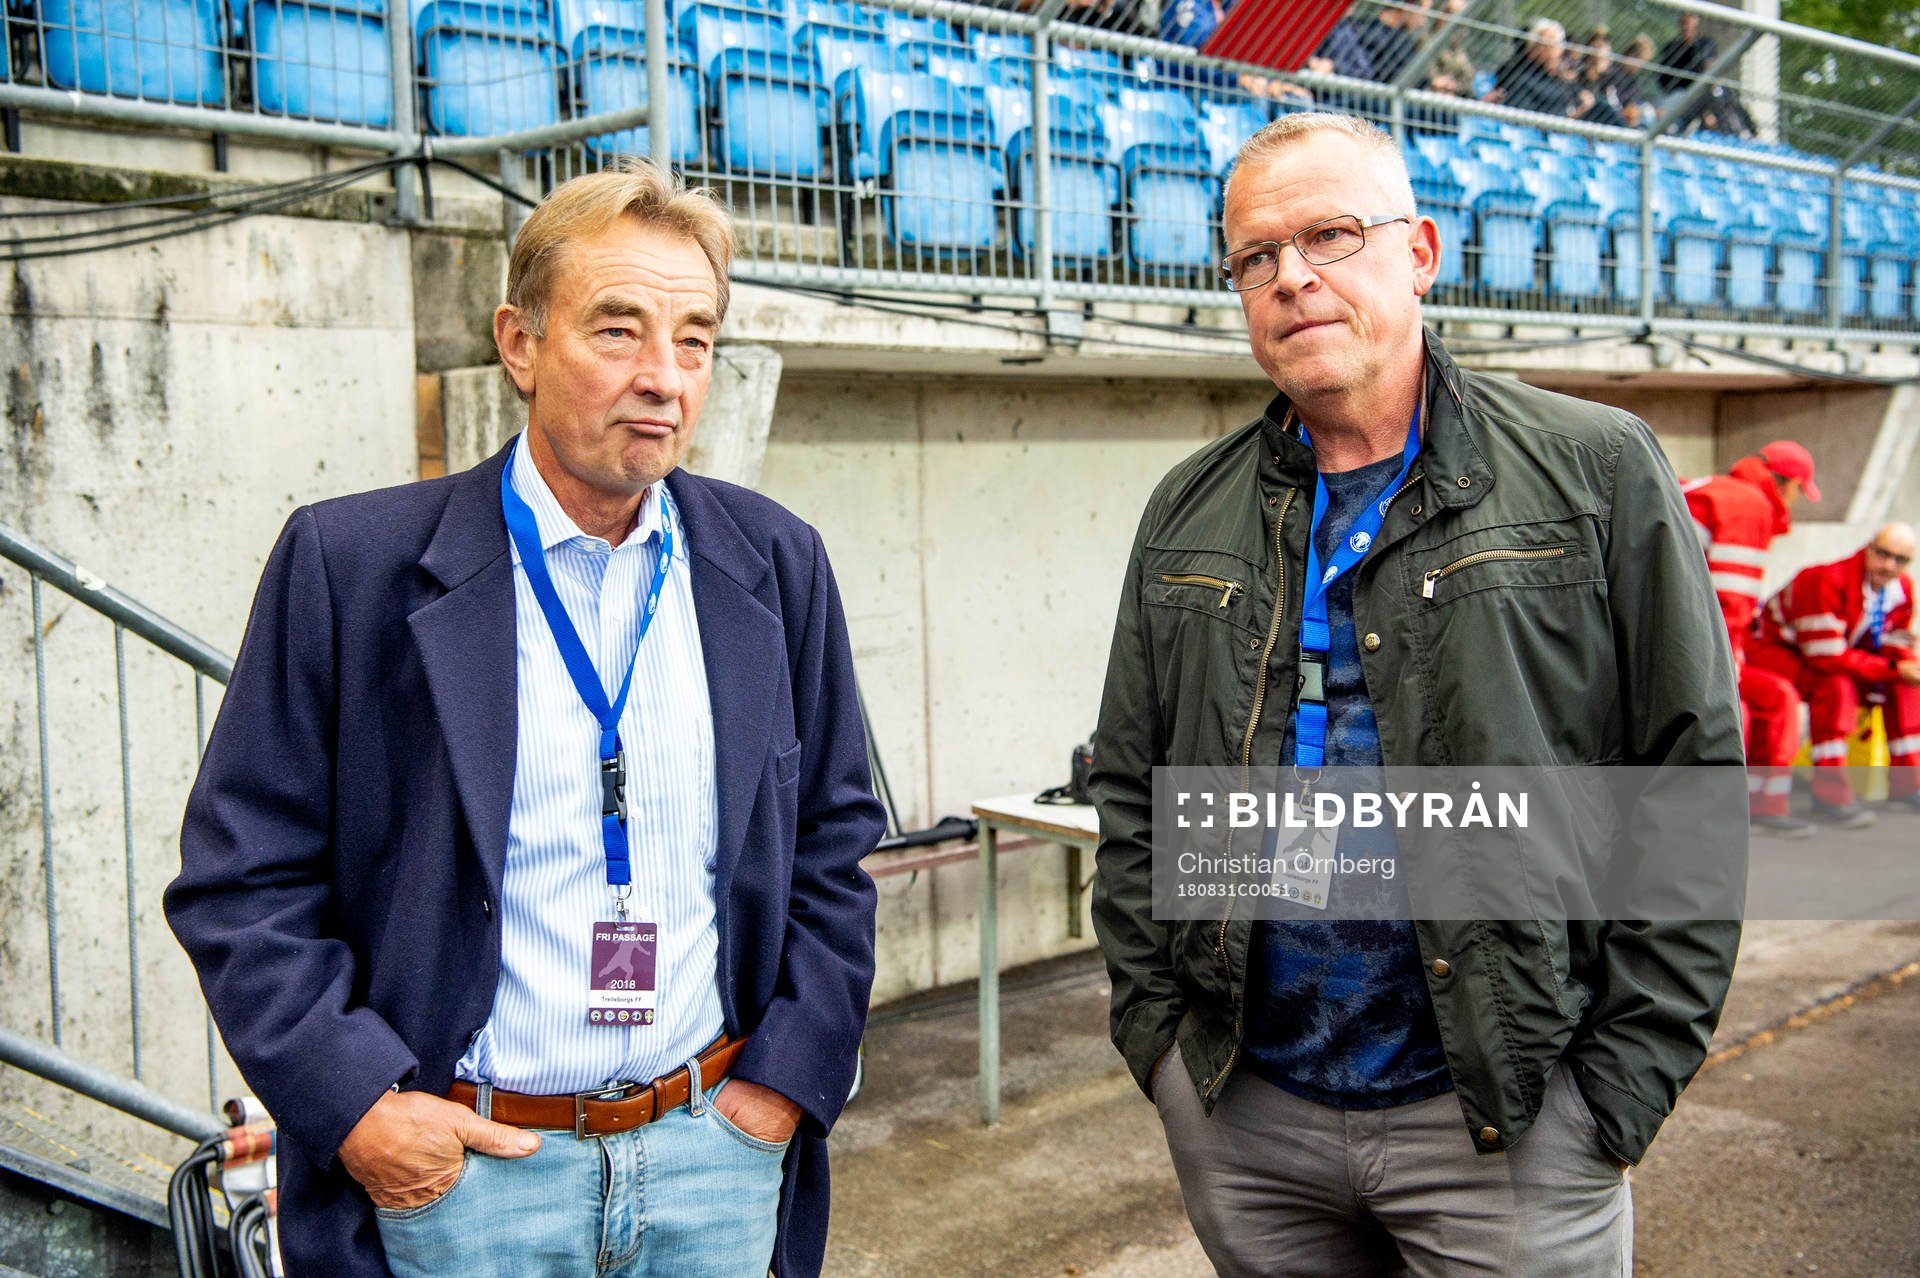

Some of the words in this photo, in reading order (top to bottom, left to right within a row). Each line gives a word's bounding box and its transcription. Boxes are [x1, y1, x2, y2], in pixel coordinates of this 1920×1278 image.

[596, 933, 611, 941] FRI
[612, 933, 656, 942] PASSAGE
[610, 979, 636, 990] 2018
